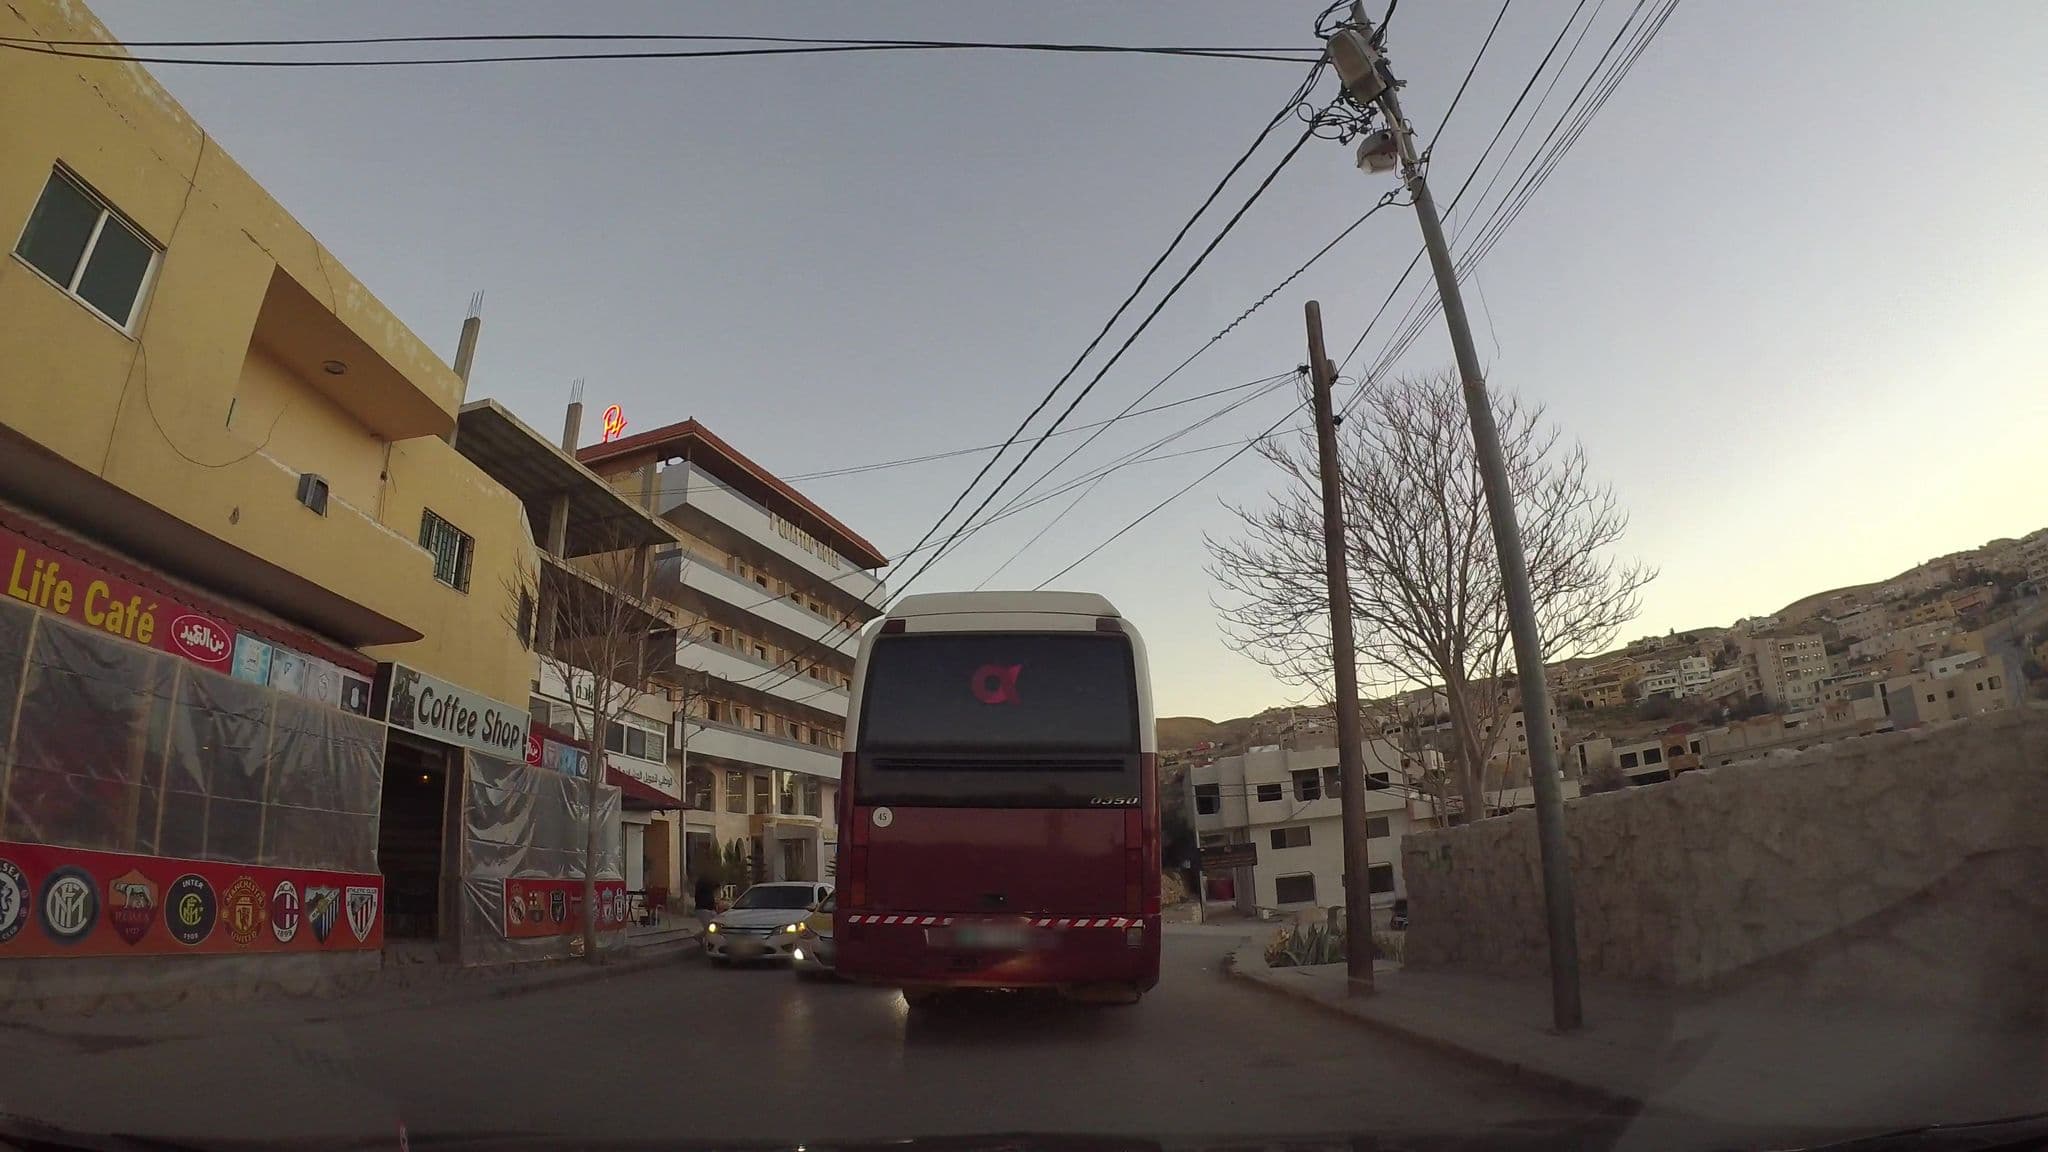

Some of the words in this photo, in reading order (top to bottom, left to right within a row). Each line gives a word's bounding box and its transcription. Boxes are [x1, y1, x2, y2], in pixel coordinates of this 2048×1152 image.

[817, 541, 841, 570] HOTEL
[8, 548, 73, 615] Life
[84, 580, 159, 644] Café
[210, 634, 225, 655] بن
[418, 686, 477, 737] Coffee
[482, 709, 520, 750] Shop
[182, 878, 204, 890] INTER
